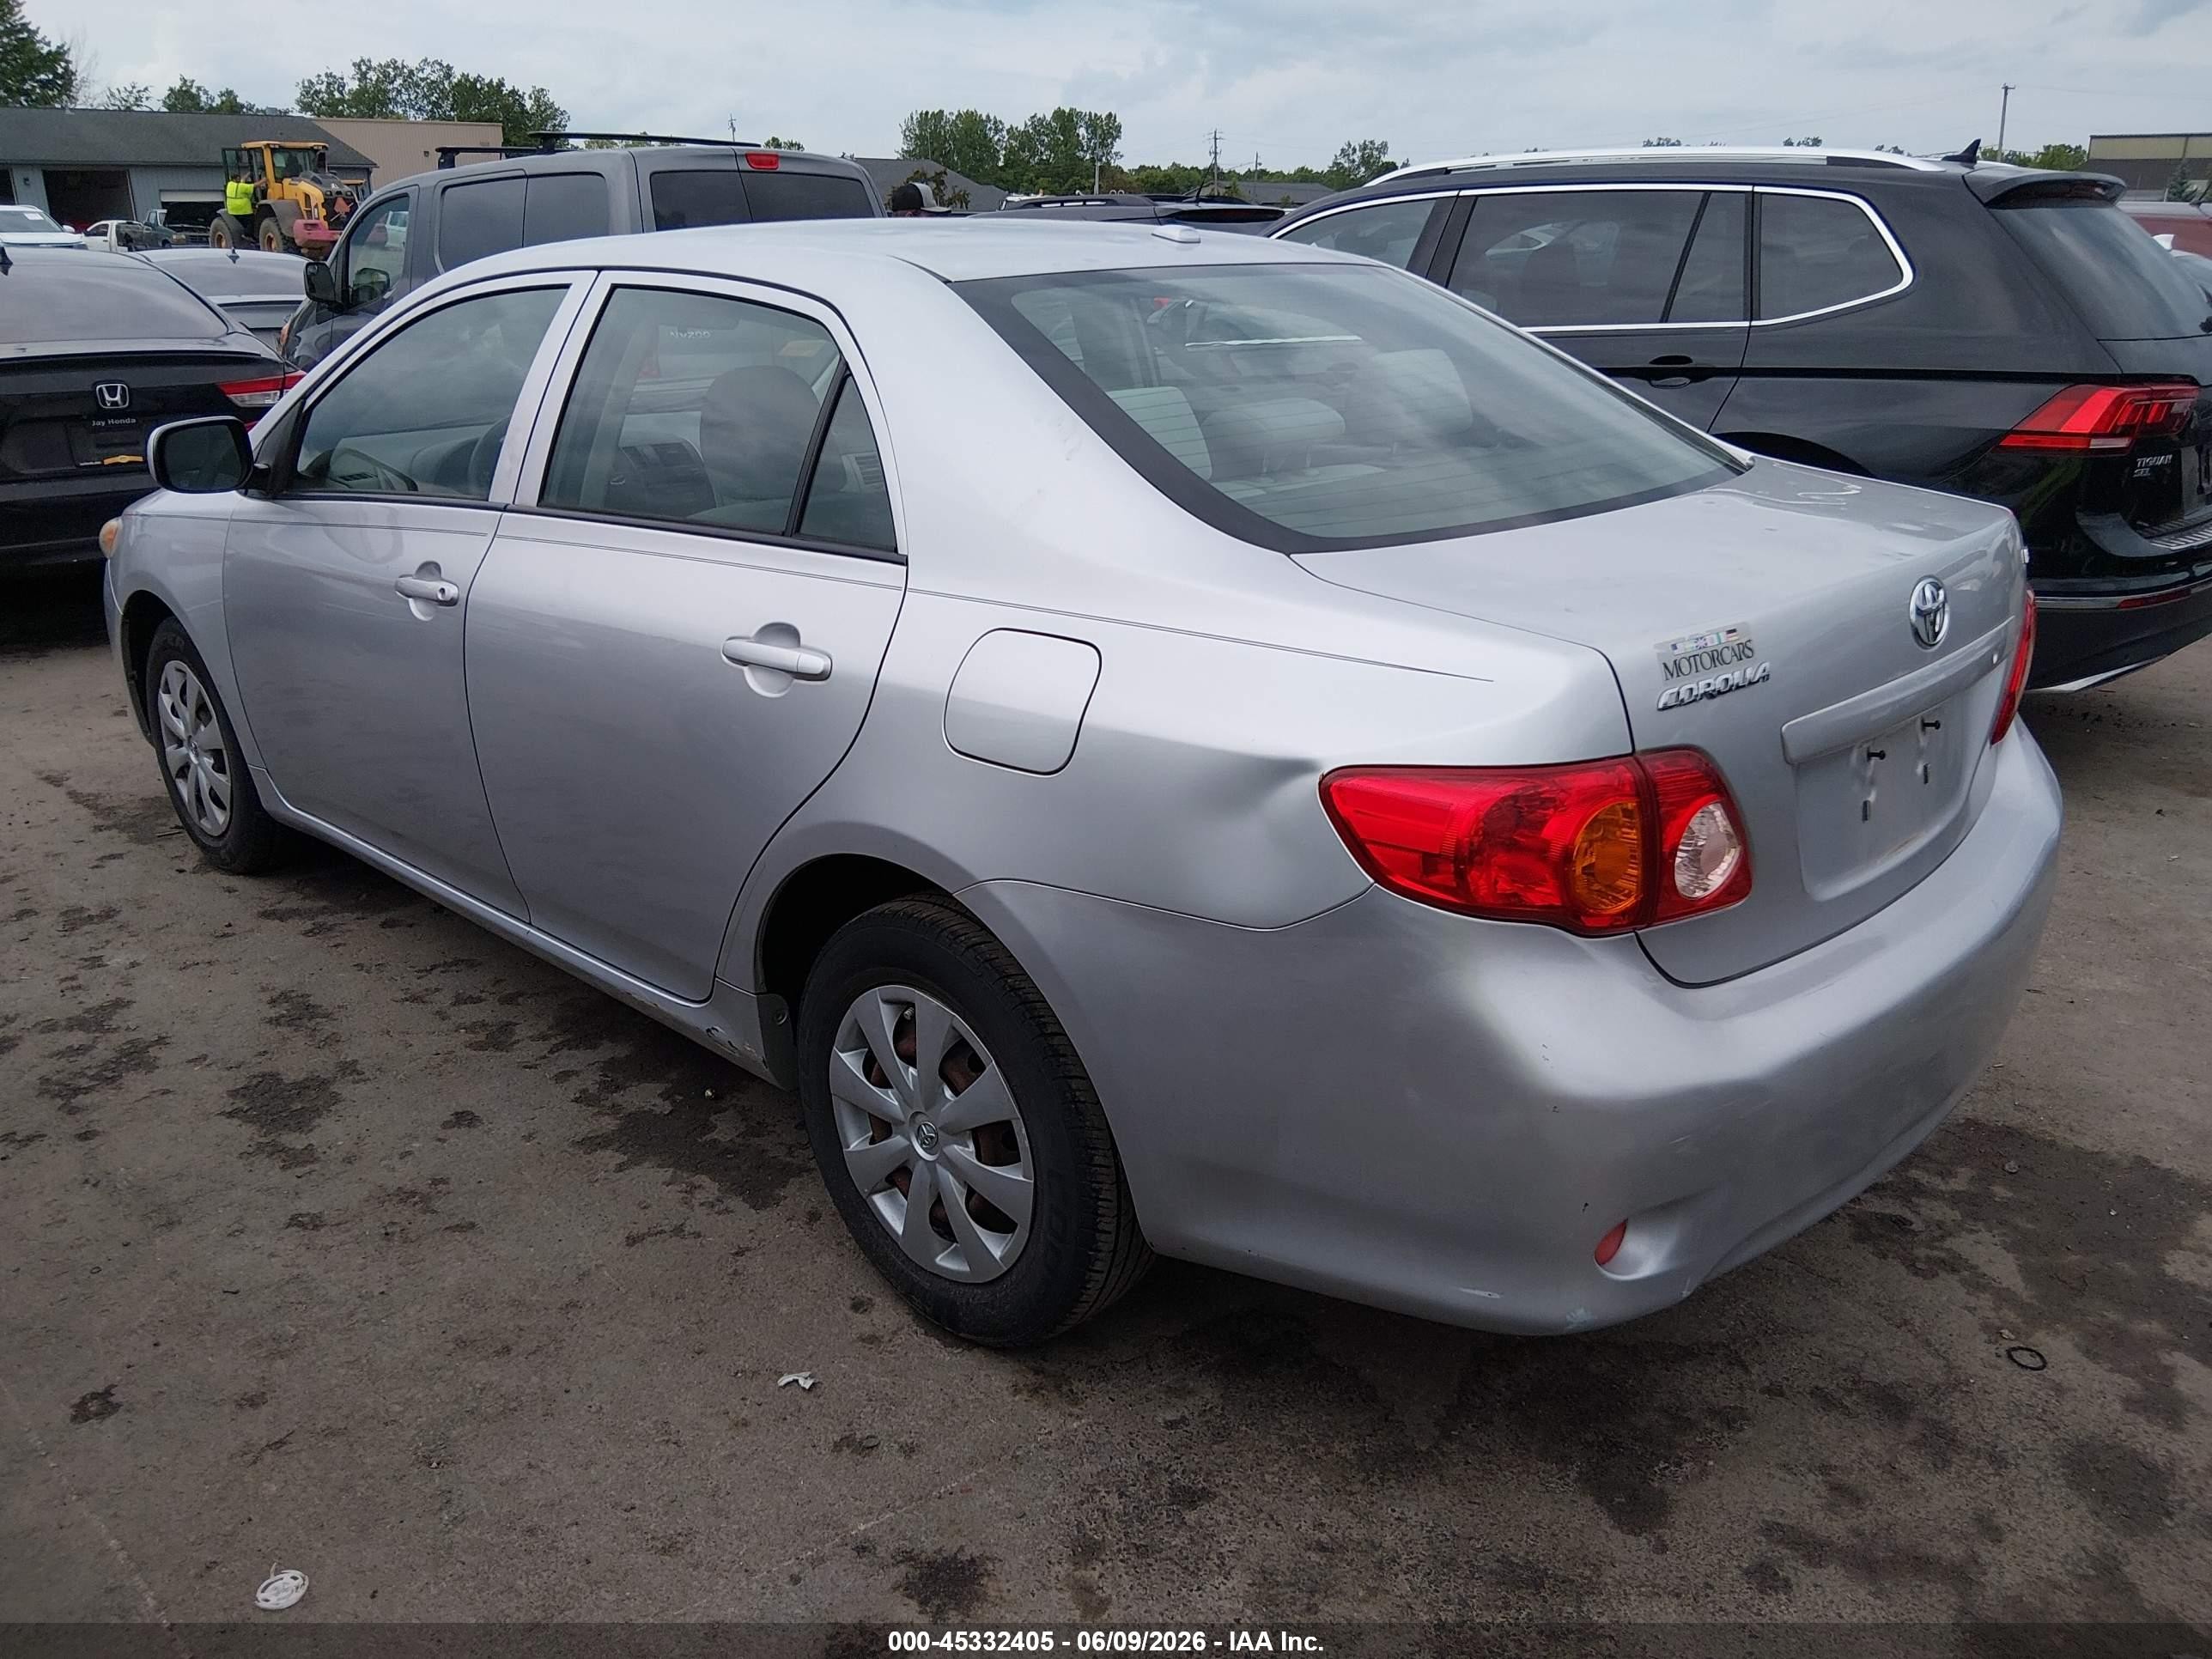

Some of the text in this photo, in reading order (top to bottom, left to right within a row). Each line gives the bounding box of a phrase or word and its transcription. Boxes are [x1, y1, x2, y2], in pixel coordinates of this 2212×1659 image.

[2136, 454, 2173, 468] TIGUAN
[1662, 640, 1754, 681] MOTORCARS
[1657, 662, 1771, 711] COROLLA
